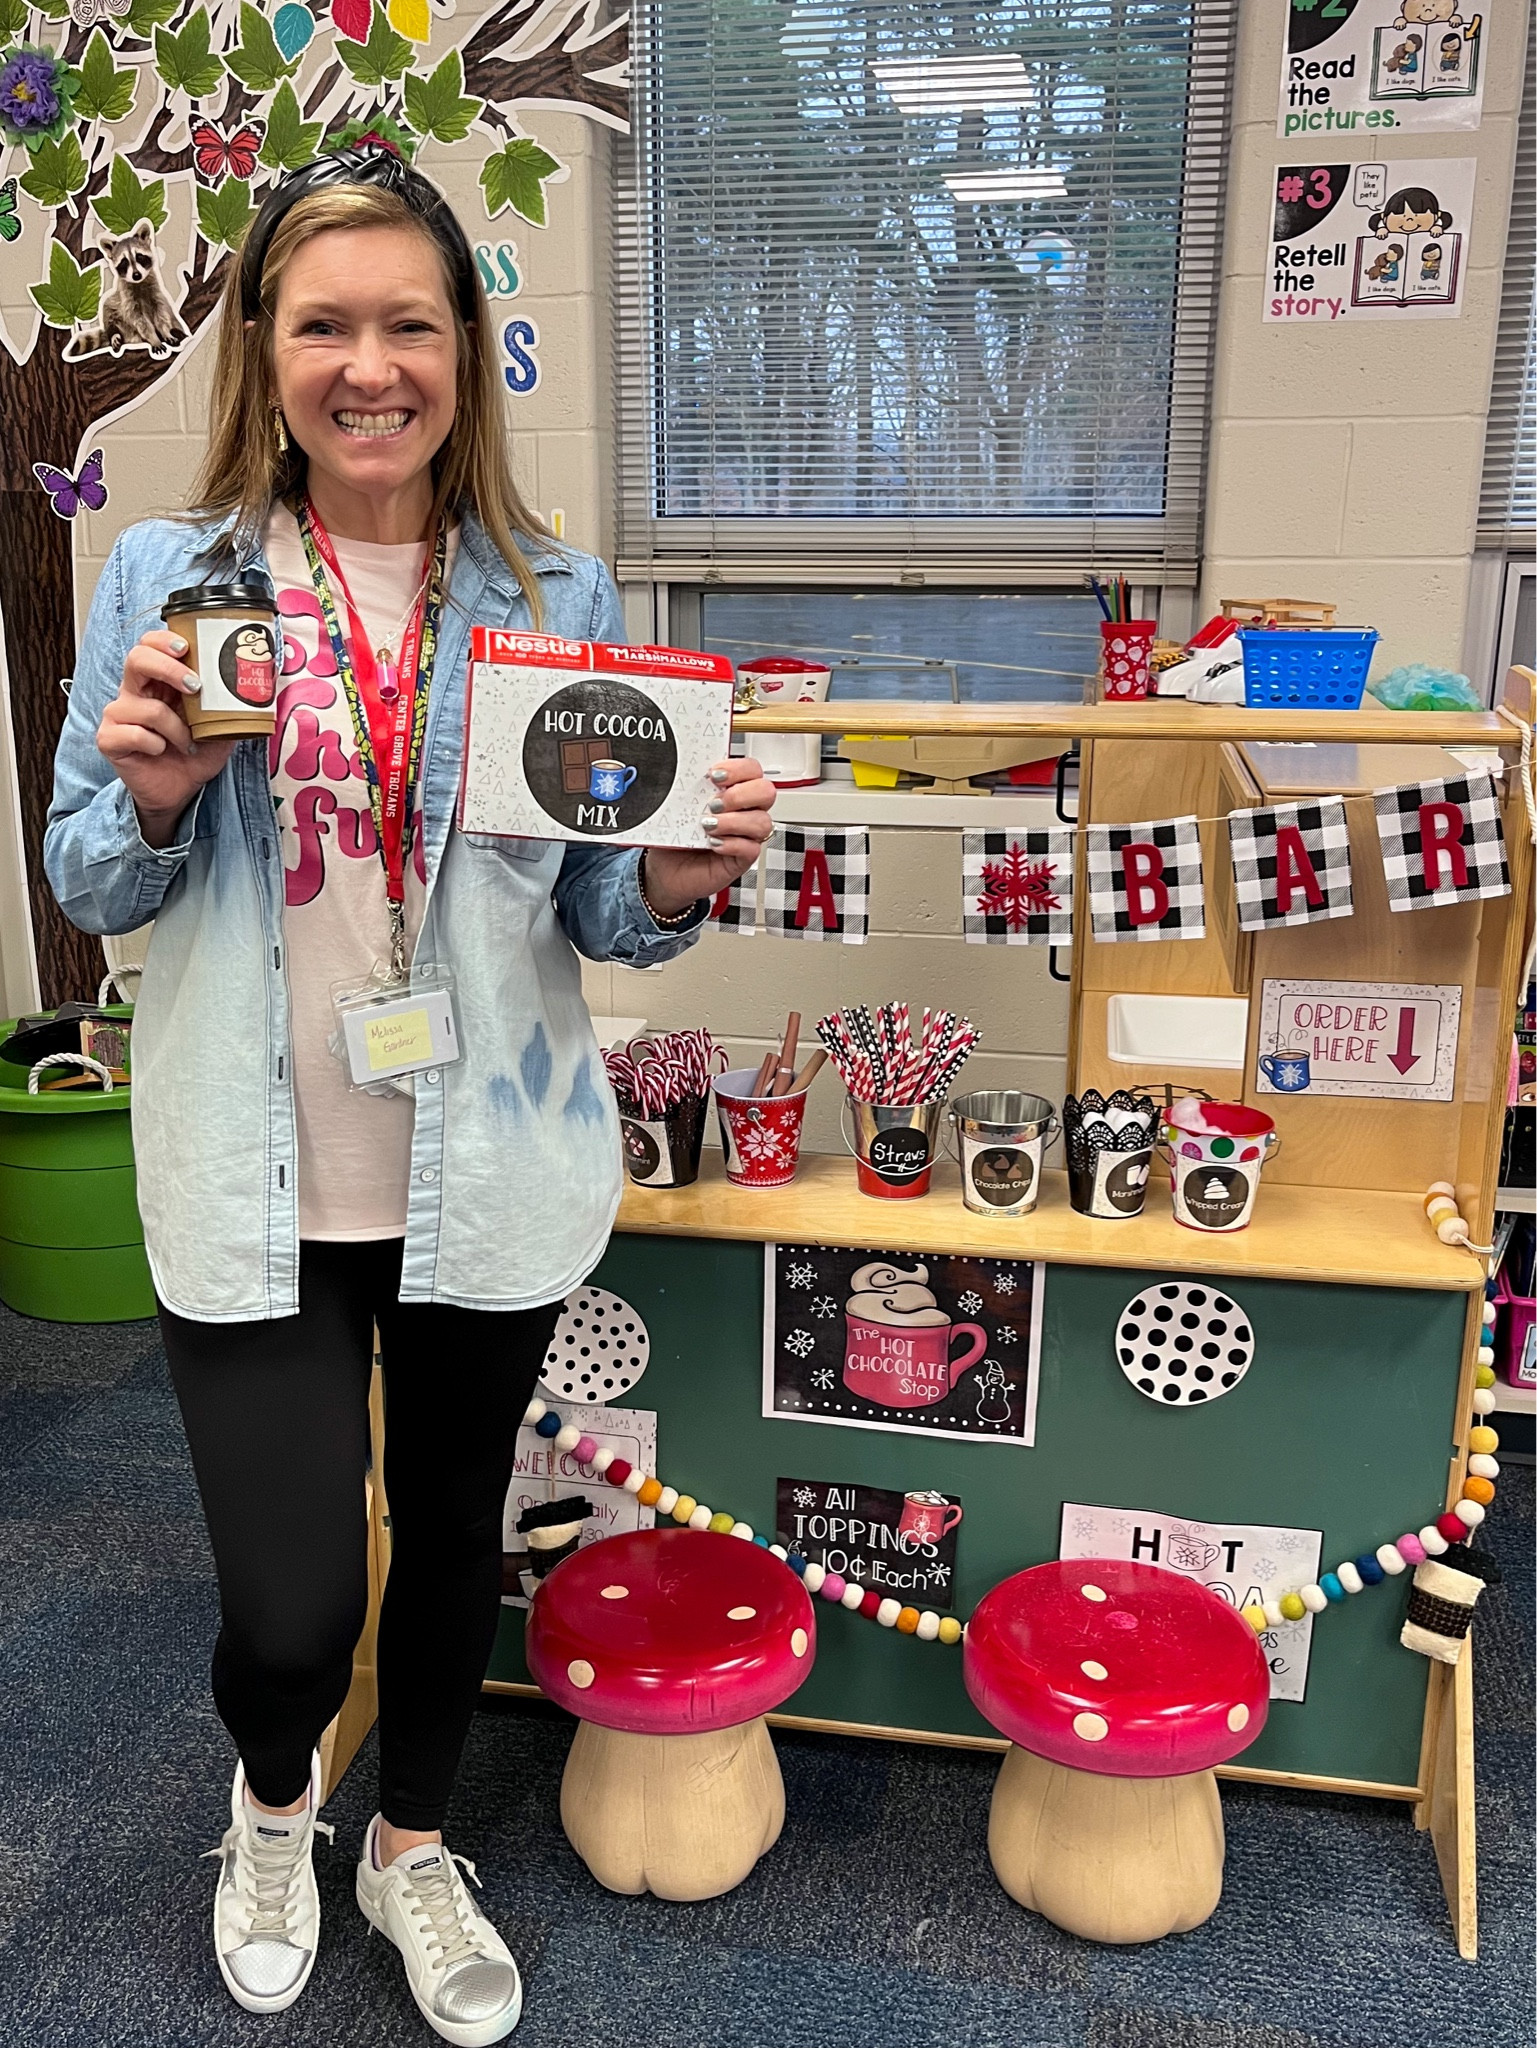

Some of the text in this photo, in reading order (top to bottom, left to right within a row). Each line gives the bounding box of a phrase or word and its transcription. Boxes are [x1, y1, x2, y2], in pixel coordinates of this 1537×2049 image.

[1289, 55, 1355, 80] Read
[1288, 84, 1330, 106] the
[1284, 107, 1401, 137] pictures.
[1362, 171, 1380, 181] They
[1363, 181, 1376, 189] like
[1278, 169, 1332, 209] #3
[1274, 244, 1346, 268] Retell
[1273, 273, 1315, 292] the
[1270, 295, 1346, 319] story.
[402, 638, 415, 679] TROJANS
[544, 711, 667, 742] HOT COCOA
[385, 695, 409, 818] CENTER GROVE TROJANS
[576, 804, 620, 828] MIX
[1294, 1003, 1388, 1032] ORDER
[371, 1025, 403, 1039] Melissa
[1313, 1036, 1380, 1063] HERE
[873, 1144, 926, 1162] Straws
[974, 1178, 1010, 1190] Chocolate
[1220, 1201, 1245, 1210] Cream
[852, 1327, 880, 1340] The
[880, 1337, 915, 1357] HOT
[847, 1353, 948, 1381] CHOCOLATE
[898, 1378, 940, 1400] Stop
[825, 1488, 856, 1511] All
[793, 1514, 939, 1558] TOPPINGS
[871, 1560, 928, 1590] Each
